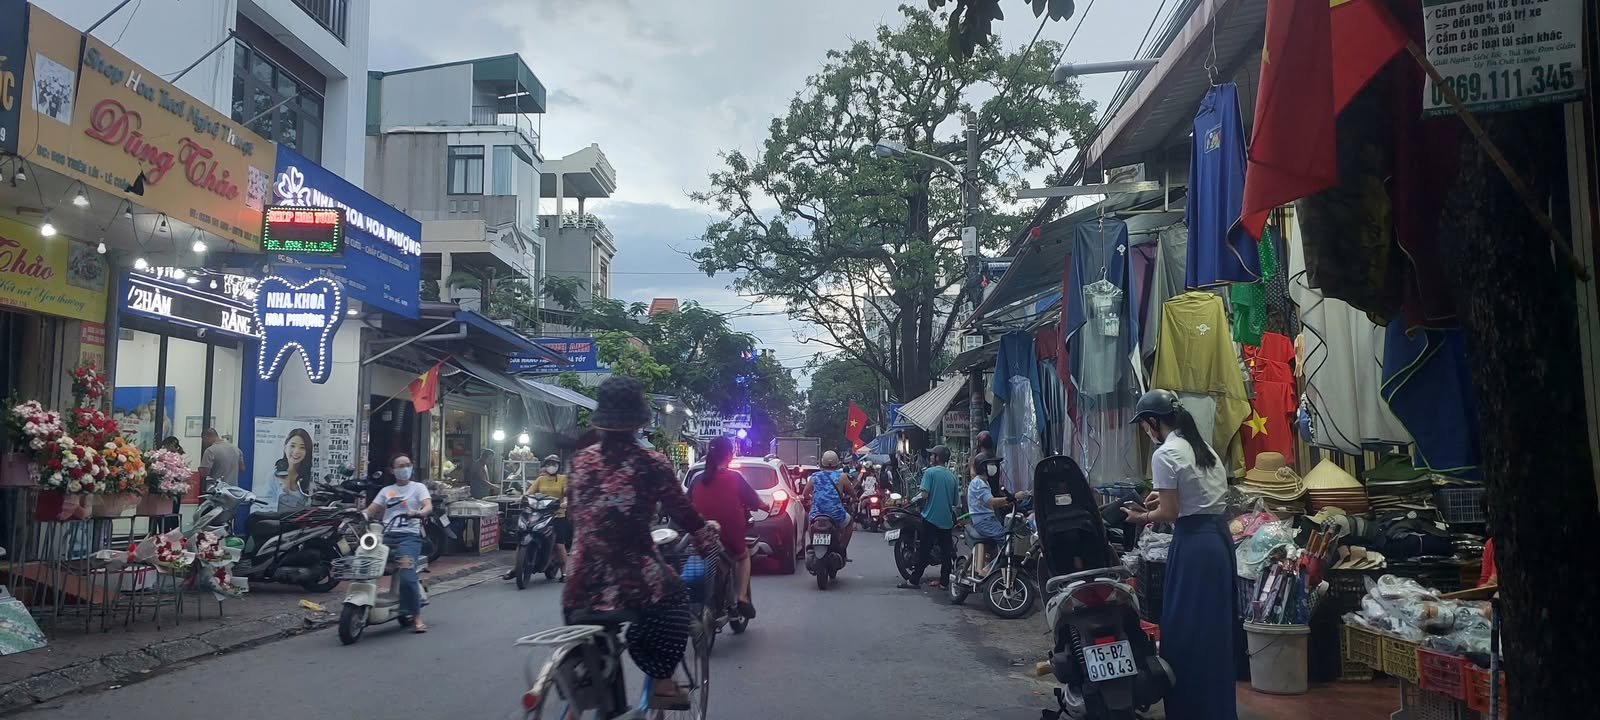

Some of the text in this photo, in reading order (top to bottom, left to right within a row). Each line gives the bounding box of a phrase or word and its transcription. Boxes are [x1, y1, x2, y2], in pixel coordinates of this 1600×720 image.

[1473, 13, 1496, 25] 90%
[1529, 8, 1542, 17] xe
[366, 215, 386, 240] HOA
[1091, 645, 1126, 662] 15-B2
[1090, 659, 1134, 679] 908.43
